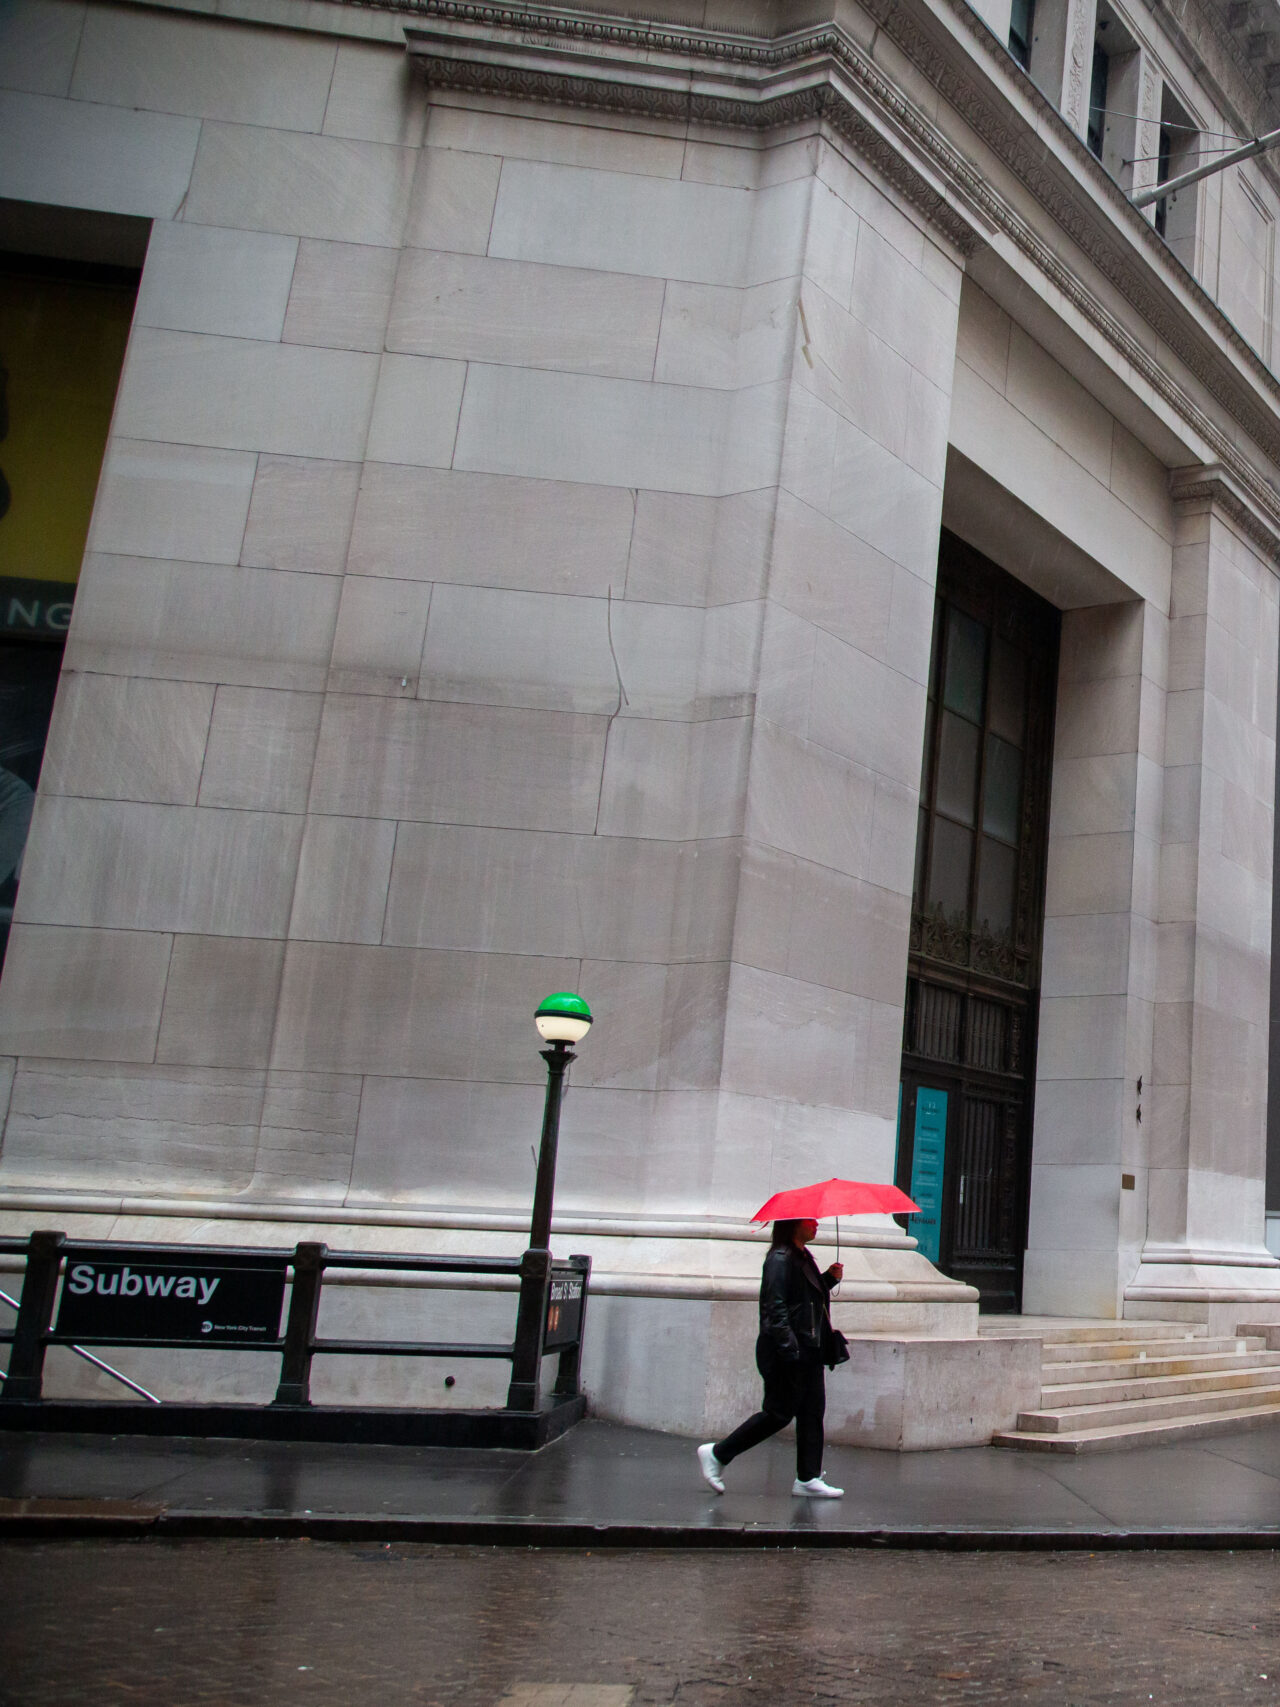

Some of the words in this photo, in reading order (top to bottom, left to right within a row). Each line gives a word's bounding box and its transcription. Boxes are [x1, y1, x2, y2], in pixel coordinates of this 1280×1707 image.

[68, 1265, 221, 1305] Subway
[551, 1282, 563, 1301] Broad
[568, 1282, 581, 1300] Station
